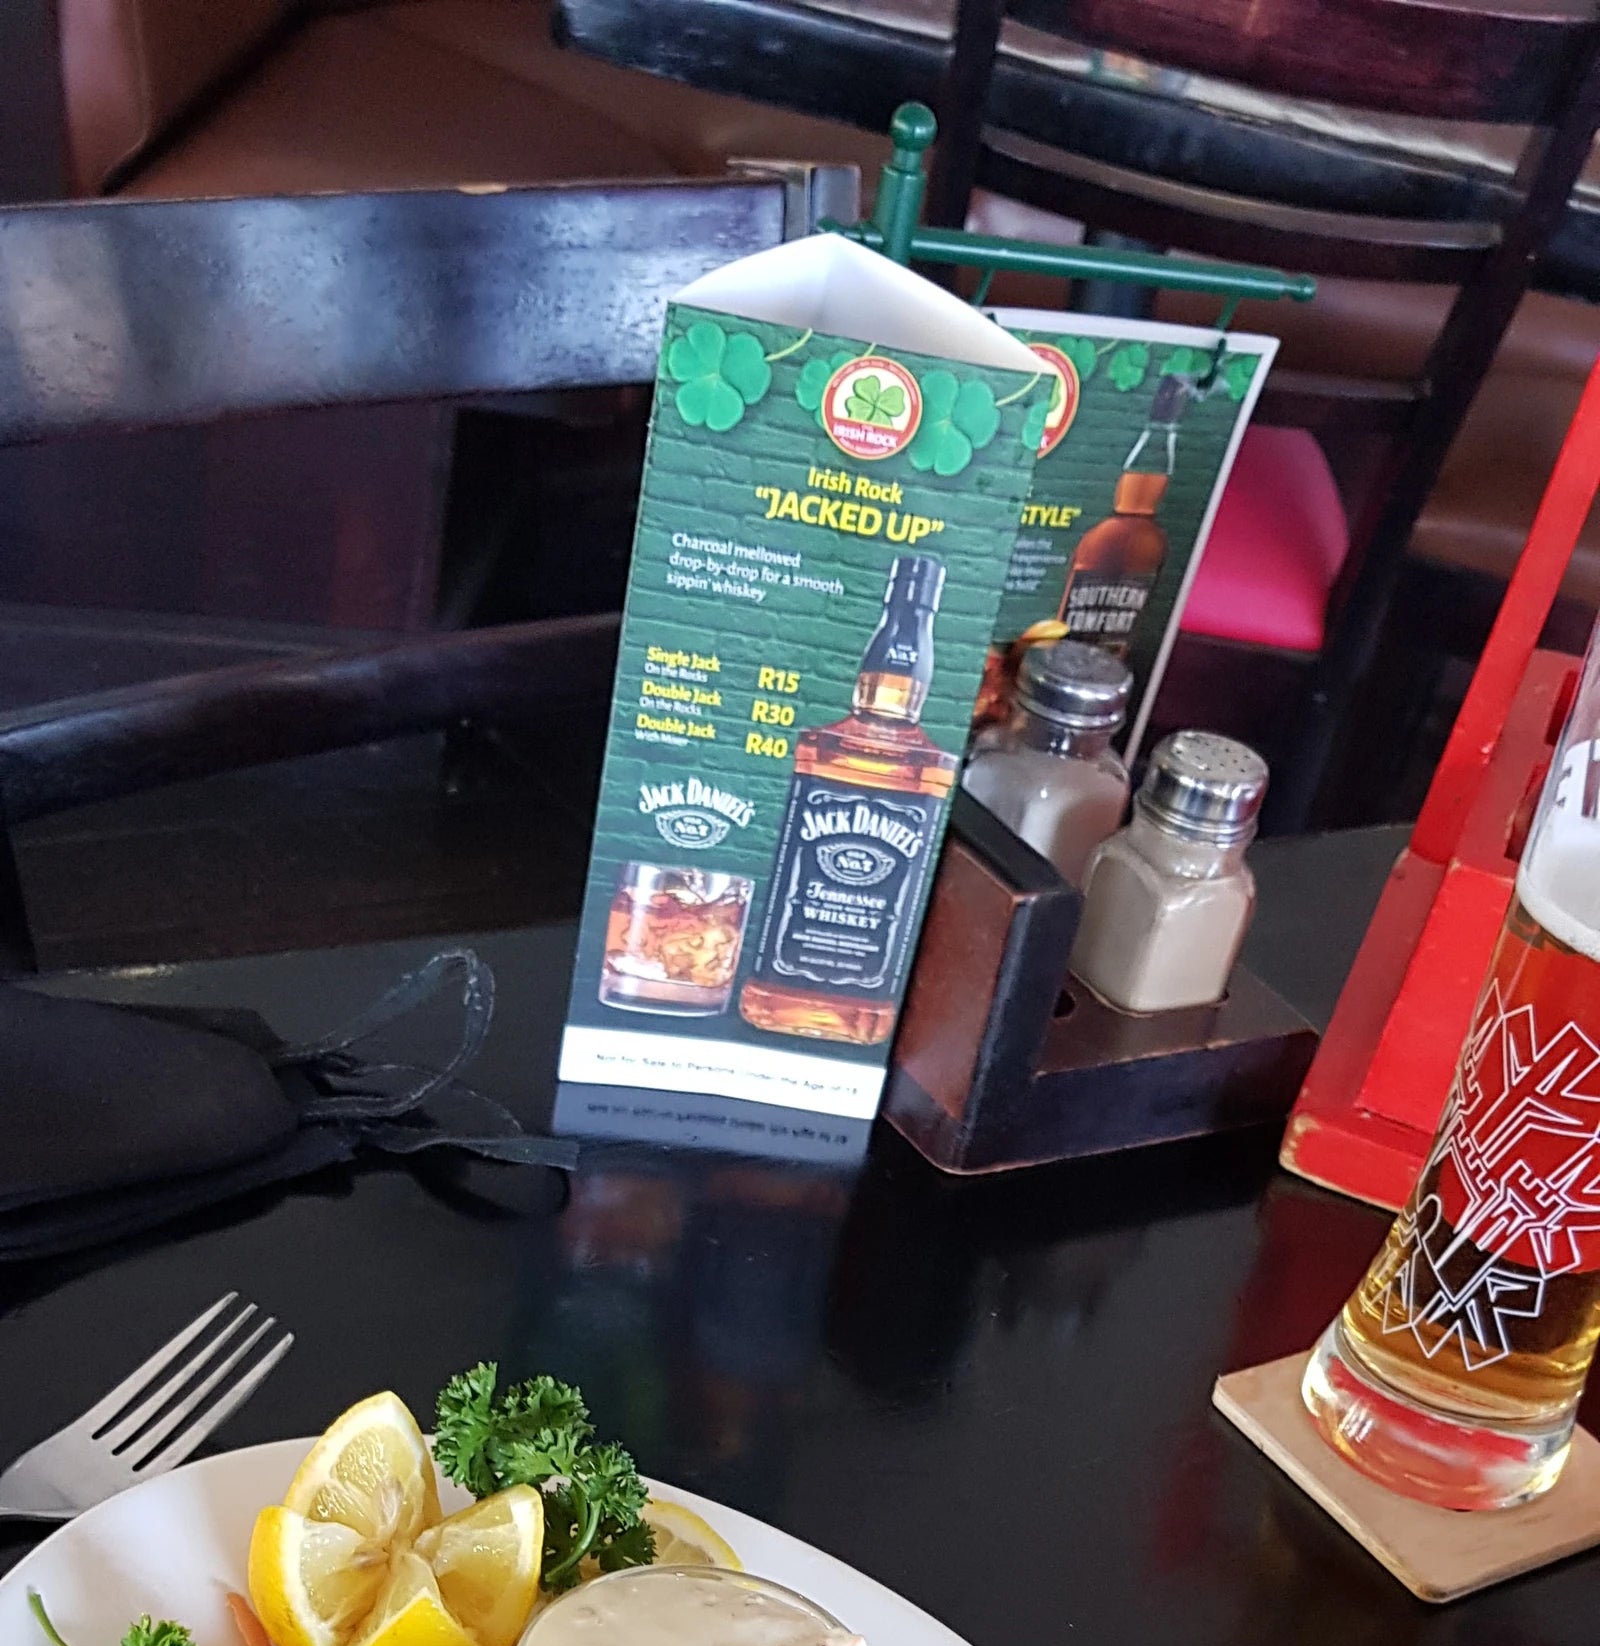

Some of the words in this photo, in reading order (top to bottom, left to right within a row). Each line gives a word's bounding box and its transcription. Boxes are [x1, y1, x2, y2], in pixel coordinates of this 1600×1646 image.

[866, 431, 898, 448] ROCK
[807, 466, 851, 494] Irish
[855, 477, 904, 504] Rock
[672, 532, 733, 556] Charcoal
[734, 544, 801, 568] mellowed
[669, 551, 759, 582] drop-by-drop
[761, 566, 781, 584] for
[782, 574, 791, 586] a
[793, 575, 845, 595] smooth
[712, 579, 766, 605] whiskey
[1068, 586, 1149, 609] SOUTHERN
[1066, 609, 1138, 632] COMFORT
[647, 645, 690, 669] Single
[691, 653, 721, 672] Jack
[644, 662, 660, 675] On
[660, 664, 678, 678] the
[678, 667, 708, 683] Rocks
[758, 665, 801, 693] R15
[639, 695, 655, 709] On
[655, 698, 673, 712] the
[672, 701, 702, 716] Rocks
[642, 680, 692, 701] Double
[692, 687, 722, 706] Jack
[637, 713, 687, 734] Double
[686, 720, 716, 739] Jack
[752, 699, 795, 727] R30
[745, 732, 788, 758] R40
[639, 783, 686, 814] JACK
[800, 809, 851, 841] JACK
[806, 880, 887, 910] Tennessee
[803, 906, 881, 929] WHISKEY
